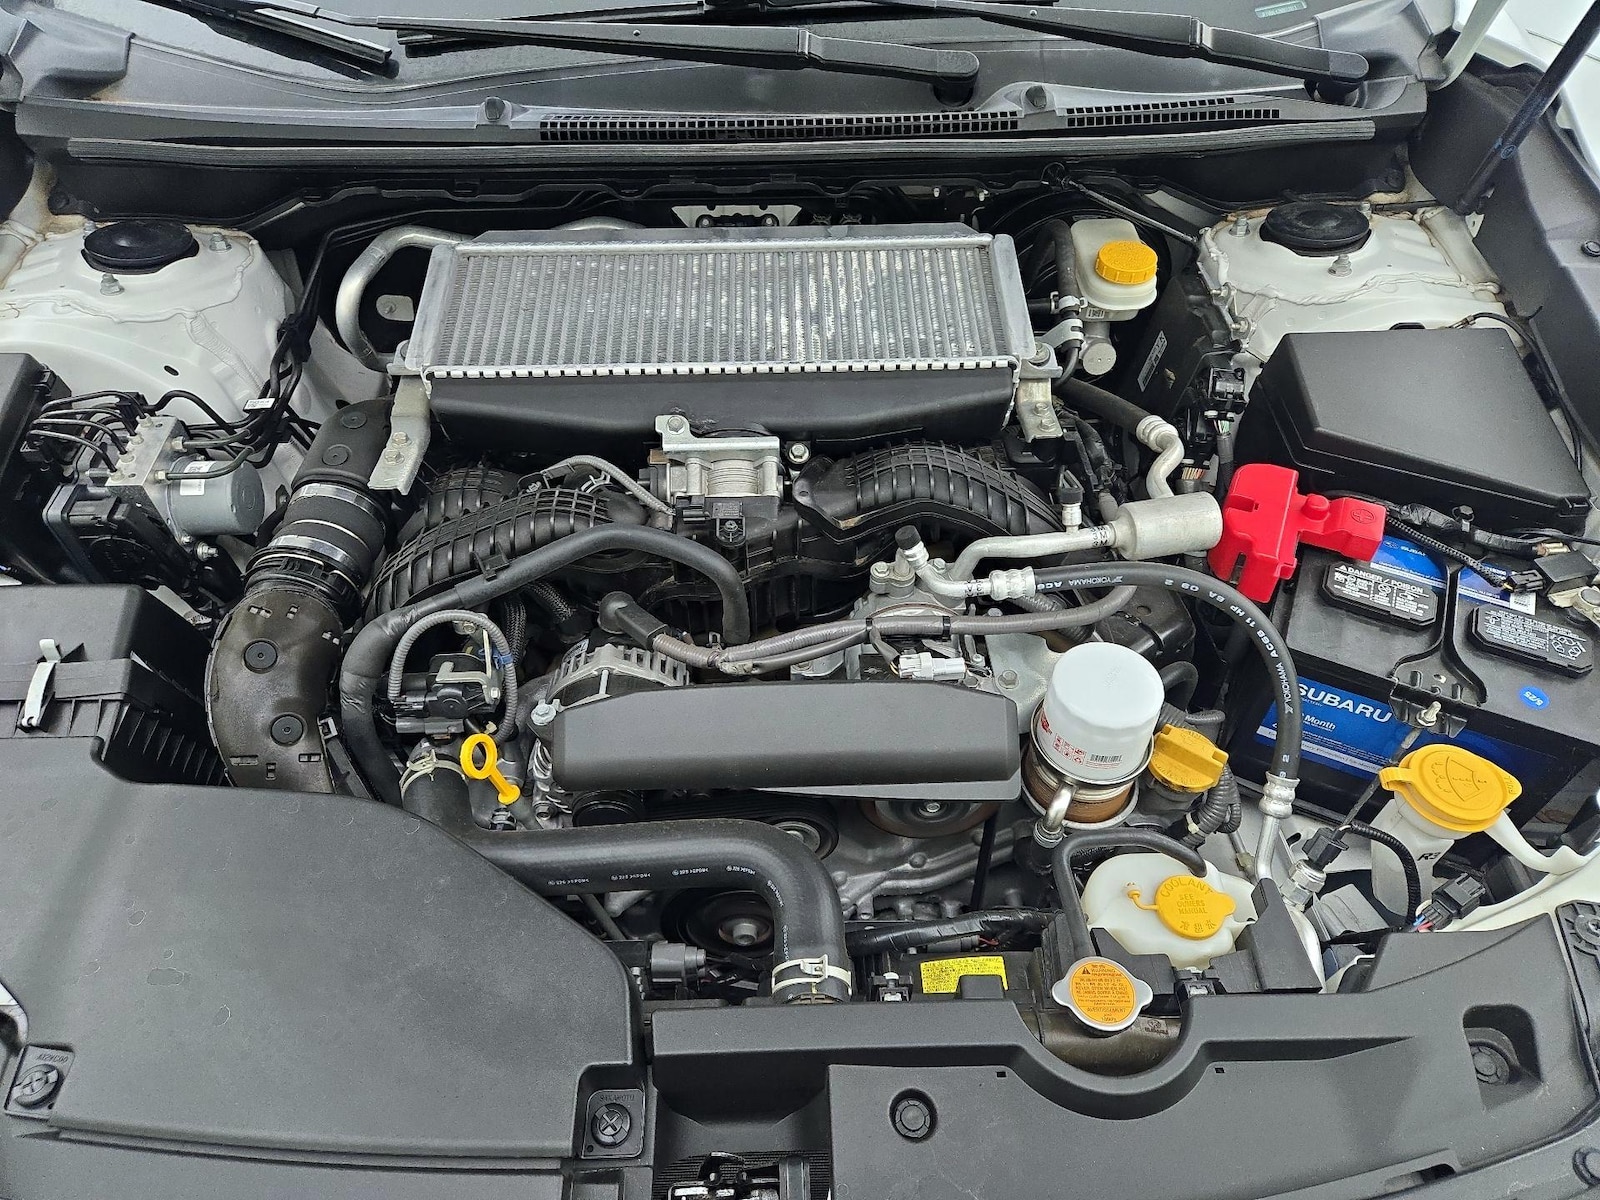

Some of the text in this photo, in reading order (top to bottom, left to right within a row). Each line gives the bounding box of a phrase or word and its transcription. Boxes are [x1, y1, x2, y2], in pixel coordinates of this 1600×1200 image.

[1068, 577, 1108, 586] YOKOHAMA
[1347, 567, 1383, 581] DANGER
[1391, 580, 1424, 593] POISON
[1230, 604, 1245, 616] HP
[1246, 617, 1256, 628] 11
[1276, 662, 1292, 702] YOKOHAMA
[1299, 684, 1392, 722] SUBARU
[1304, 716, 1336, 730] Month
[1160, 878, 1213, 897] COOLANT
